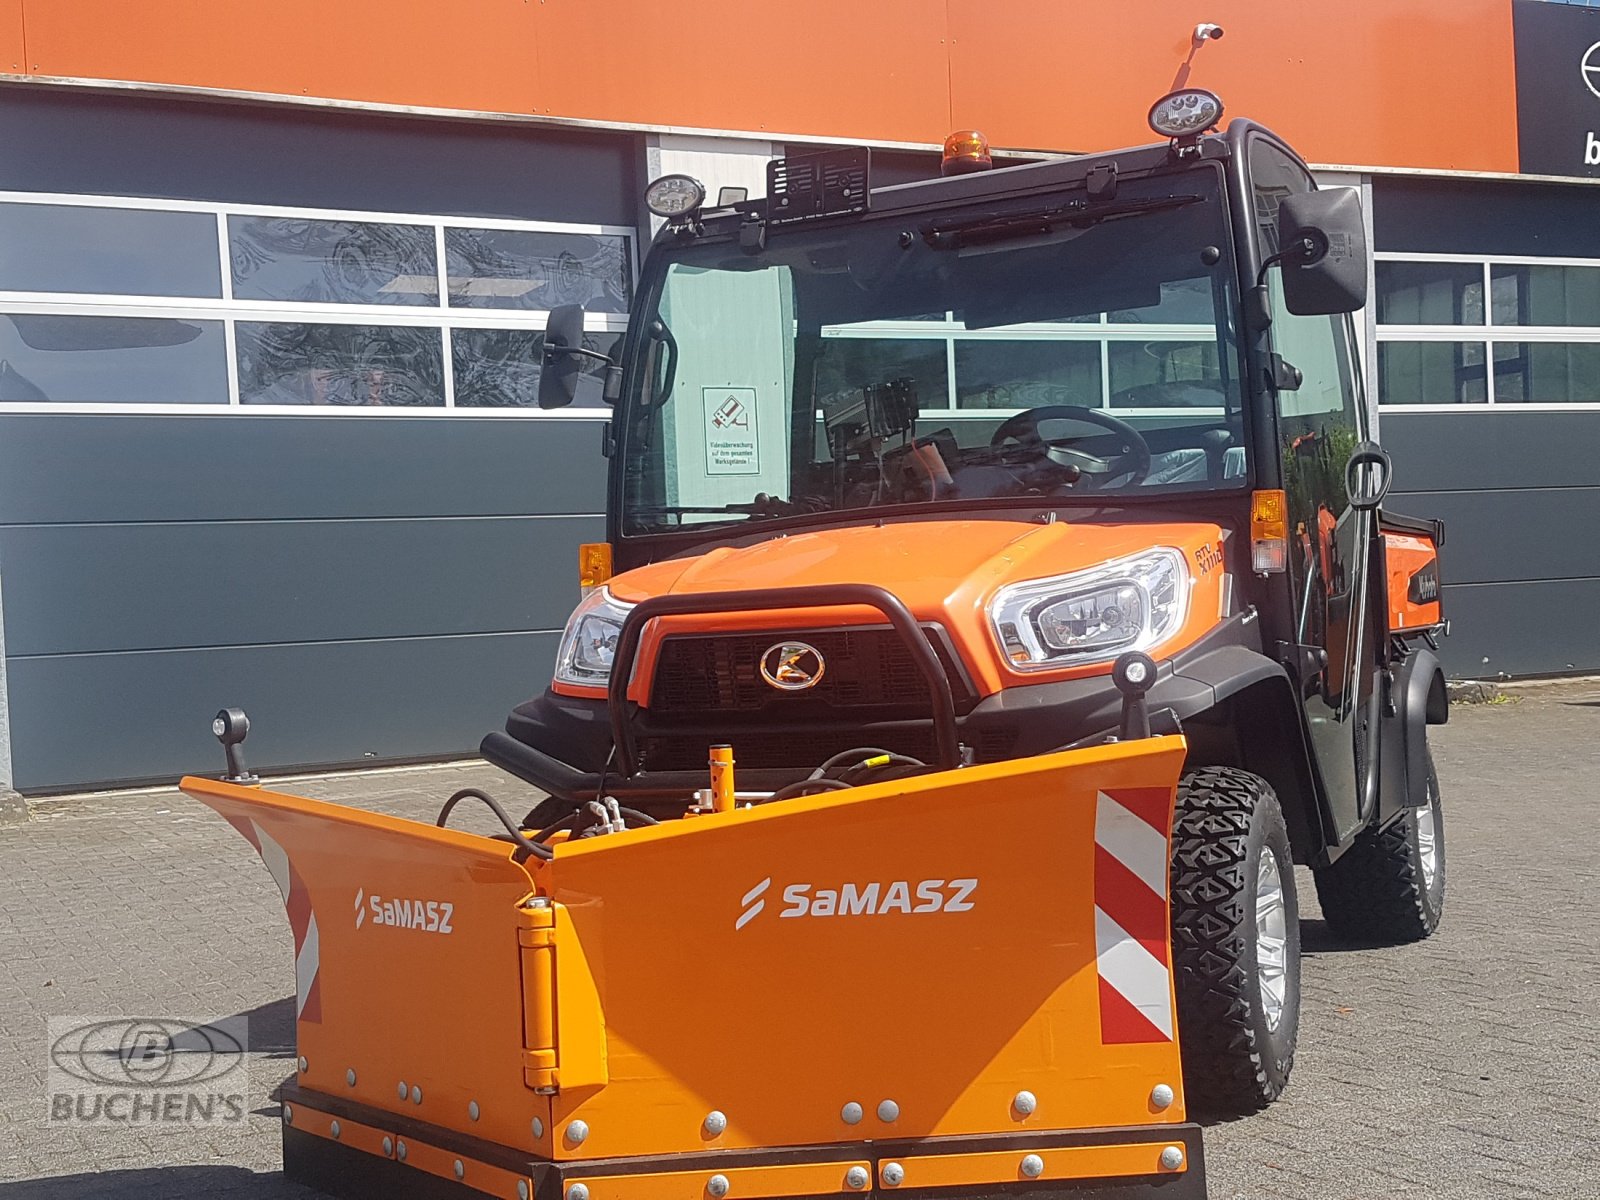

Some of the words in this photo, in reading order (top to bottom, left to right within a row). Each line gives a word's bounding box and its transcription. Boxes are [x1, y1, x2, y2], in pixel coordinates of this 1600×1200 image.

[1195, 544, 1210, 561] RTV
[370, 895, 453, 934] SaMASZ
[779, 878, 978, 918] SaMASZ
